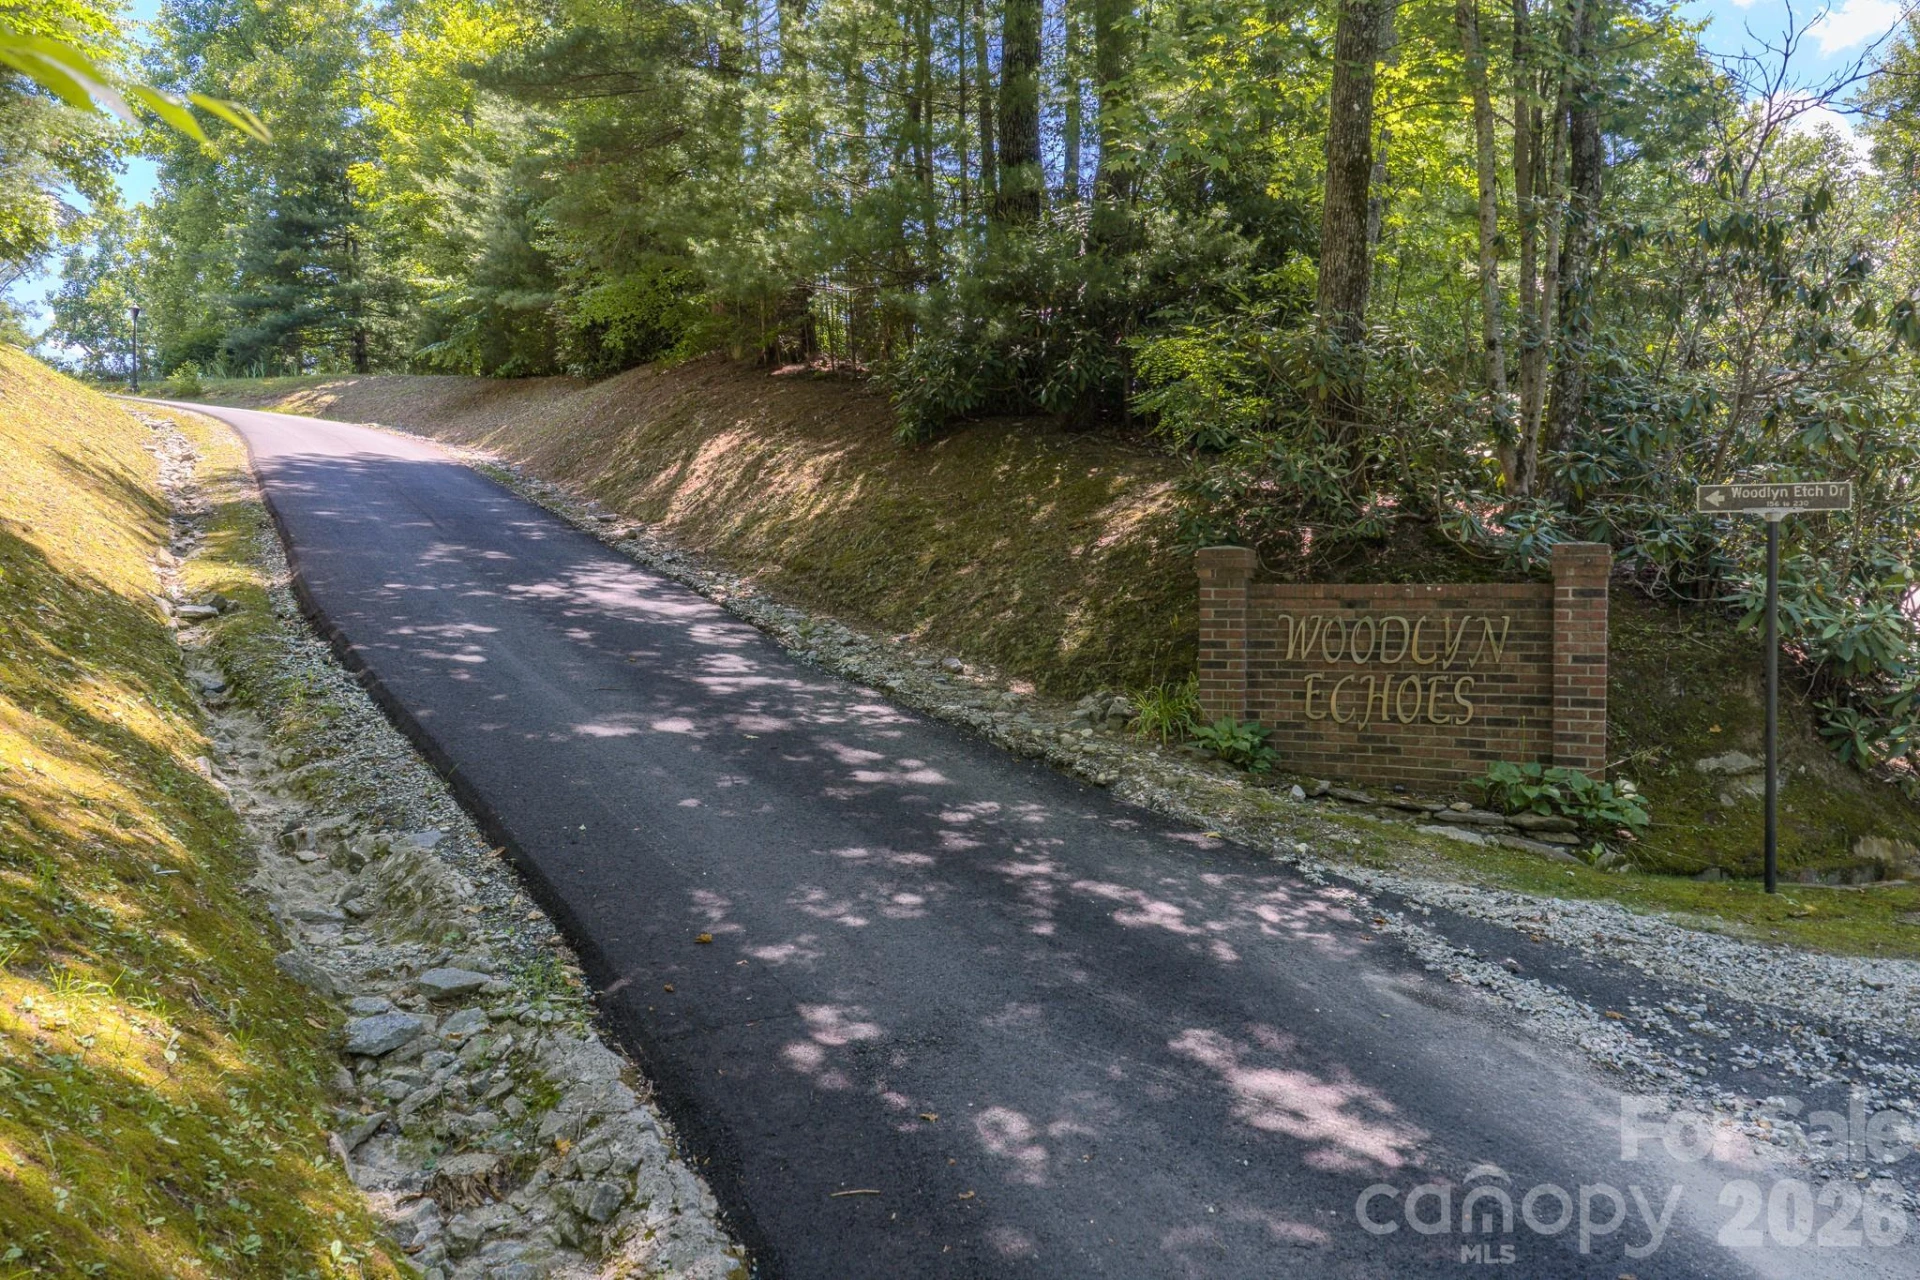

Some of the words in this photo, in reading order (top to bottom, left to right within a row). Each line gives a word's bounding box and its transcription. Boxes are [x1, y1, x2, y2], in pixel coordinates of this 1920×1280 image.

[1731, 486, 1789, 499] Woodlyn
[1794, 485, 1824, 498] Etch
[1829, 484, 1845, 496] Dr
[1278, 614, 1511, 670] WOODLYN
[1304, 673, 1475, 731] ECHOES
